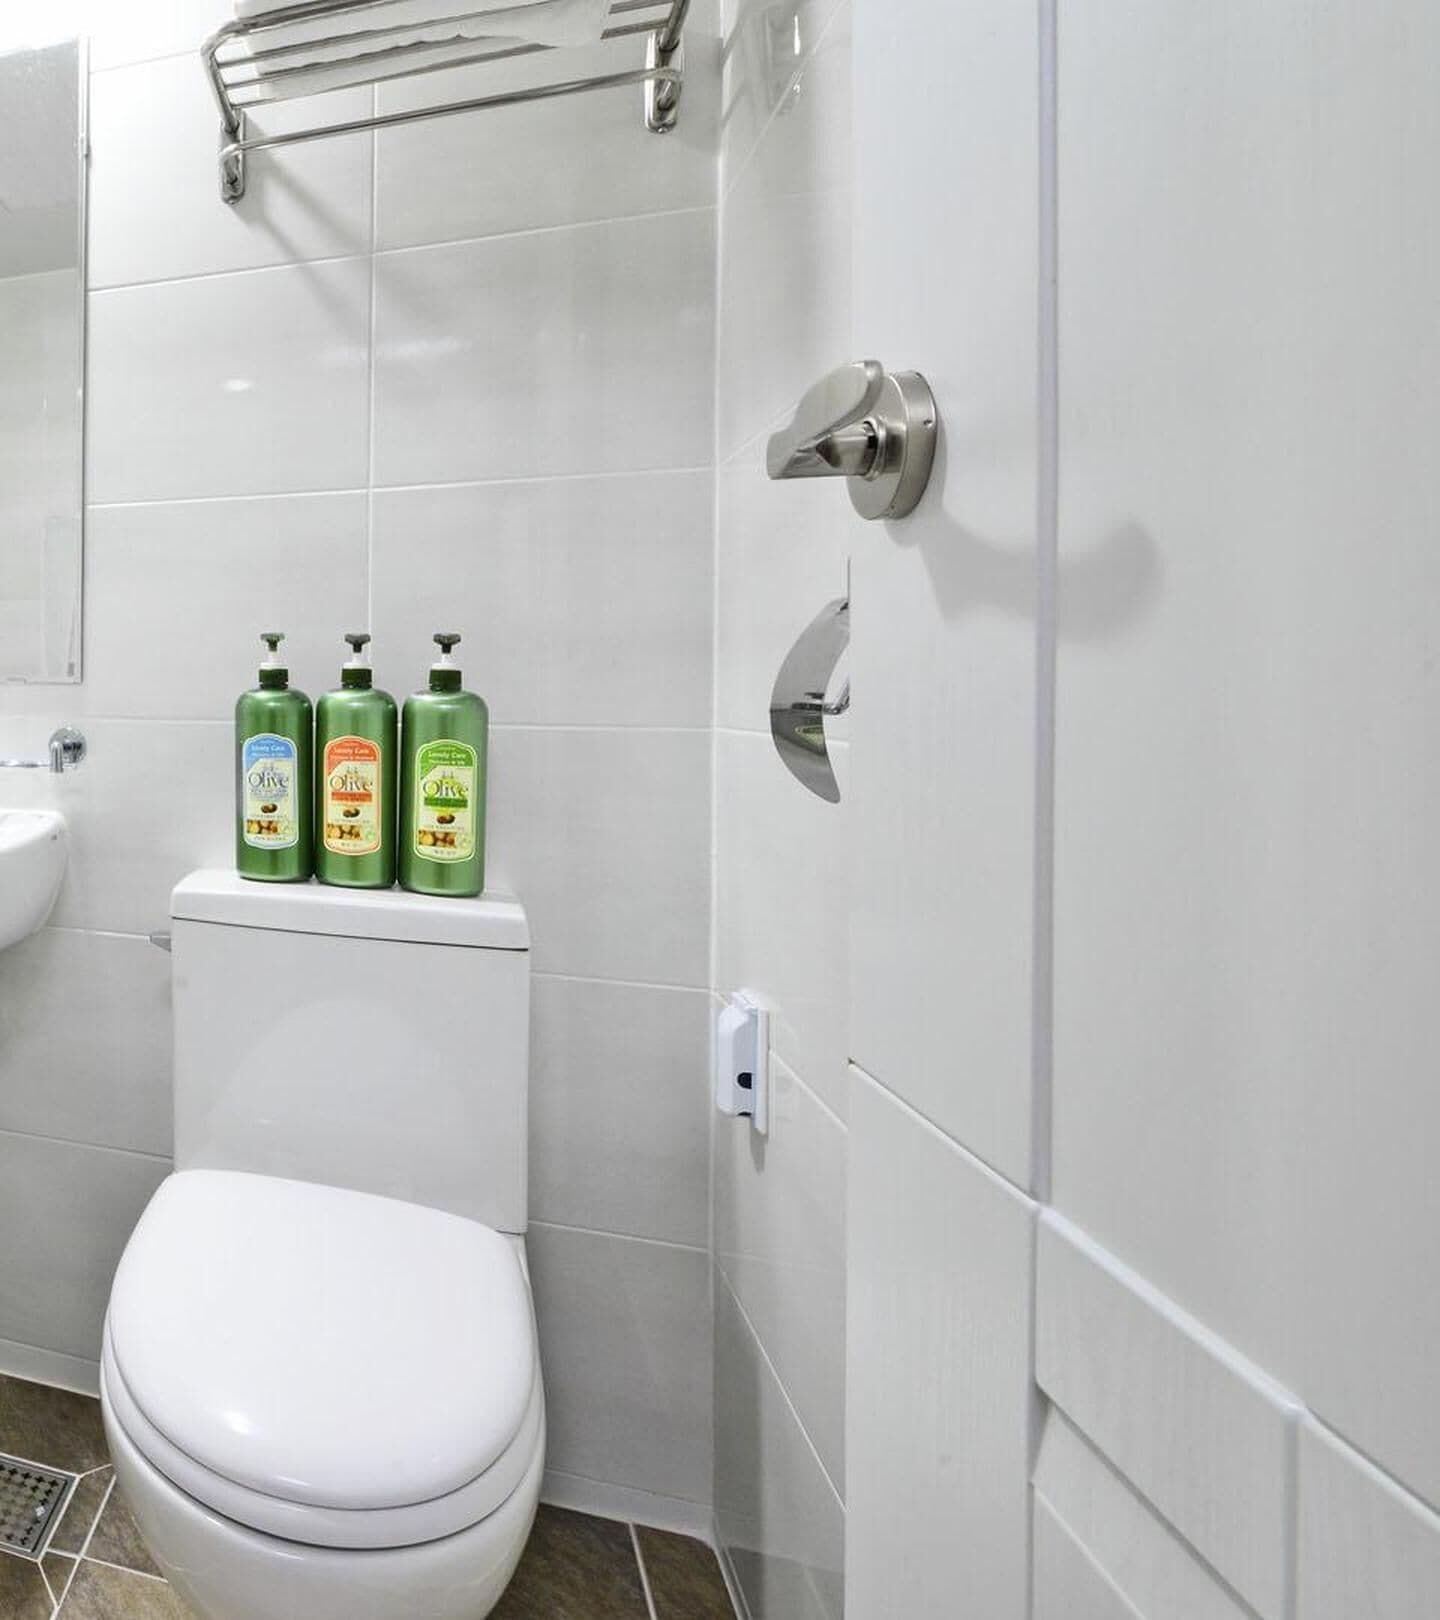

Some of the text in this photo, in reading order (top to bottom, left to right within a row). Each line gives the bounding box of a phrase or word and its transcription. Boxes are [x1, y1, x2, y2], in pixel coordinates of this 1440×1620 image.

[248, 771, 289, 789] Olive
[329, 774, 373, 791] Olive
[422, 779, 469, 797] Olive
